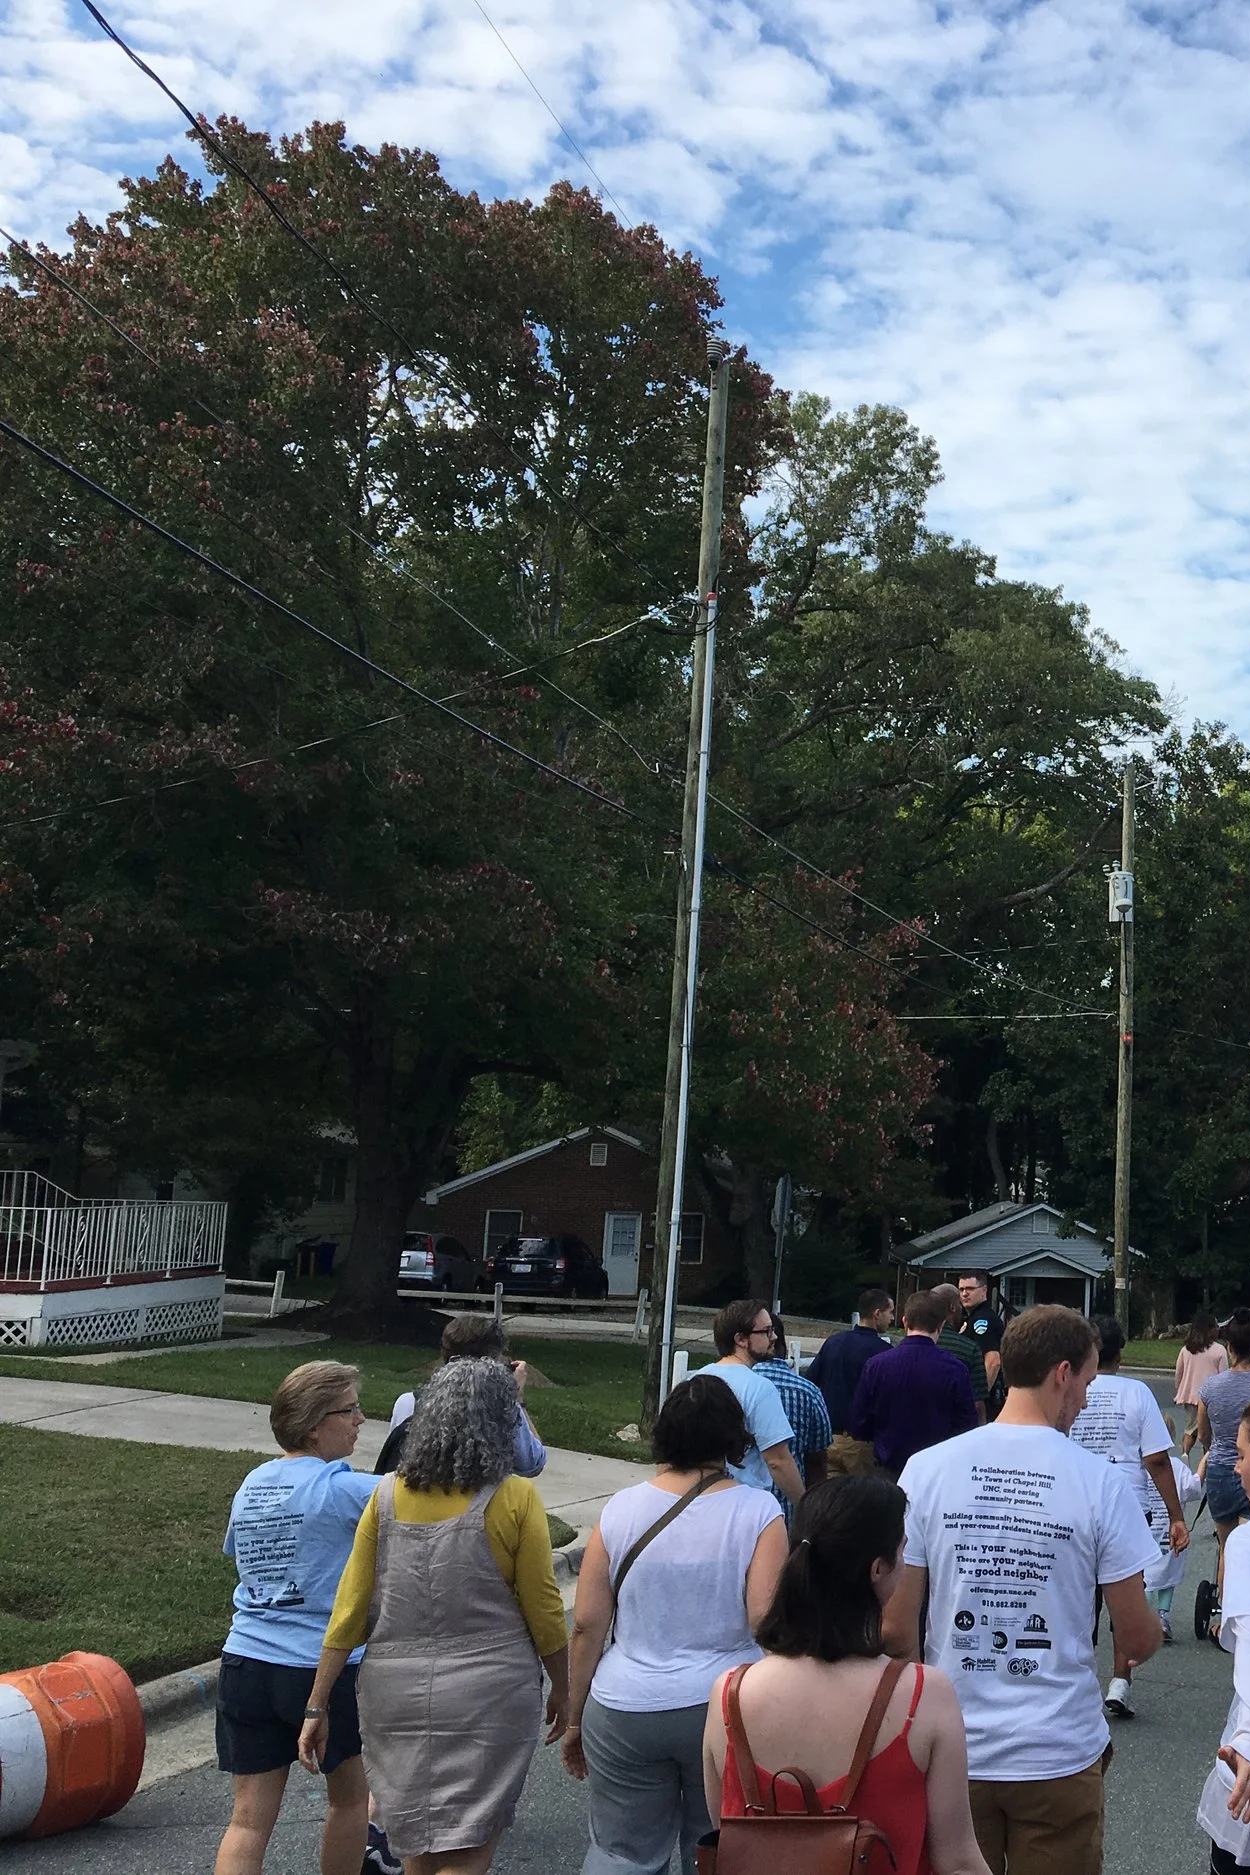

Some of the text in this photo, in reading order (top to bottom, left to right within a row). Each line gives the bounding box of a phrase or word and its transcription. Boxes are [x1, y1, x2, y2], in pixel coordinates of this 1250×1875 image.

[979, 1467, 1025, 1476] collaboration
[1027, 1471, 1055, 1480] between
[1012, 1478, 1037, 1487] Chapel
[1018, 1489, 1040, 1498] caring
[974, 1495, 1044, 1507] community partners.
[975, 1514, 1012, 1523] community
[1014, 1516, 1041, 1527] between
[1043, 1522, 1074, 1533] students
[960, 1523, 1000, 1531] year-round
[1001, 1524, 1031, 1534] residents
[1033, 1528, 1052, 1538] since
[981, 1545, 1006, 1553] your
[1010, 1548, 1056, 1560] neighborhood.
[992, 1557, 1015, 1566] your
[975, 1568, 1001, 1577] good
[1003, 1569, 1048, 1582] neighbor
